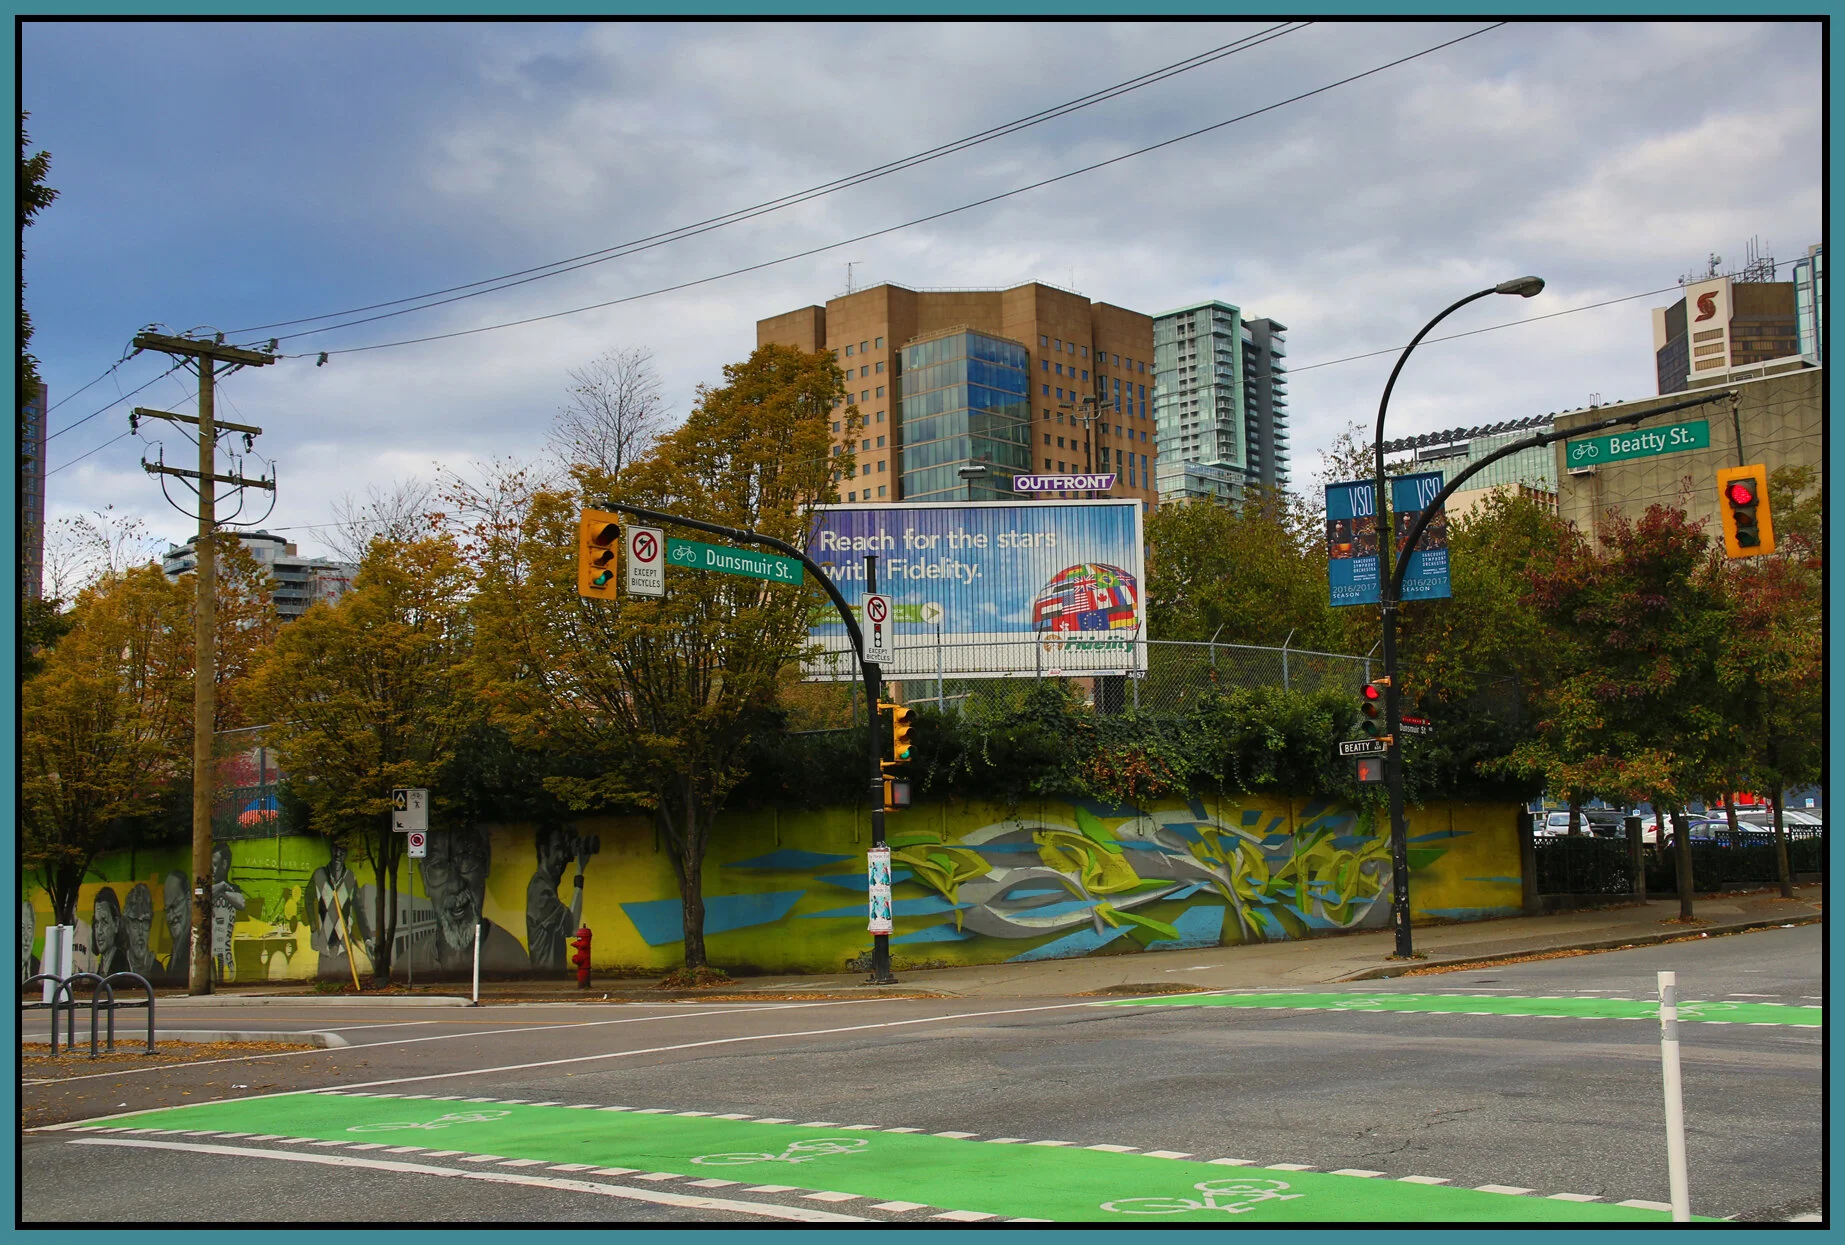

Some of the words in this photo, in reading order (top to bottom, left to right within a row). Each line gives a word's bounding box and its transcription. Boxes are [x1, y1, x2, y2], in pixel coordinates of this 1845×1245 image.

[1610, 432, 1666, 455] Beatty
[1670, 427, 1695, 445] St.
[1017, 475, 1111, 490] OUTFRONT
[1348, 485, 1373, 517] VSO
[820, 528, 895, 552] Reach
[903, 527, 940, 550] for
[946, 527, 988, 549] the
[997, 529, 1057, 548] stars
[706, 549, 772, 576] Dunsmuir
[775, 561, 793, 580] St.
[634, 567, 657, 578] EXCEPT
[887, 557, 983, 585] Fidelity.
[631, 577, 661, 589] BICYCLES
[1333, 583, 1377, 593] 2016/2017
[1402, 577, 1448, 587] 2016/2017
[866, 653, 890, 661] BICYCLES
[868, 647, 888, 655] EXCEPT
[1344, 742, 1370, 753] BEATTY
